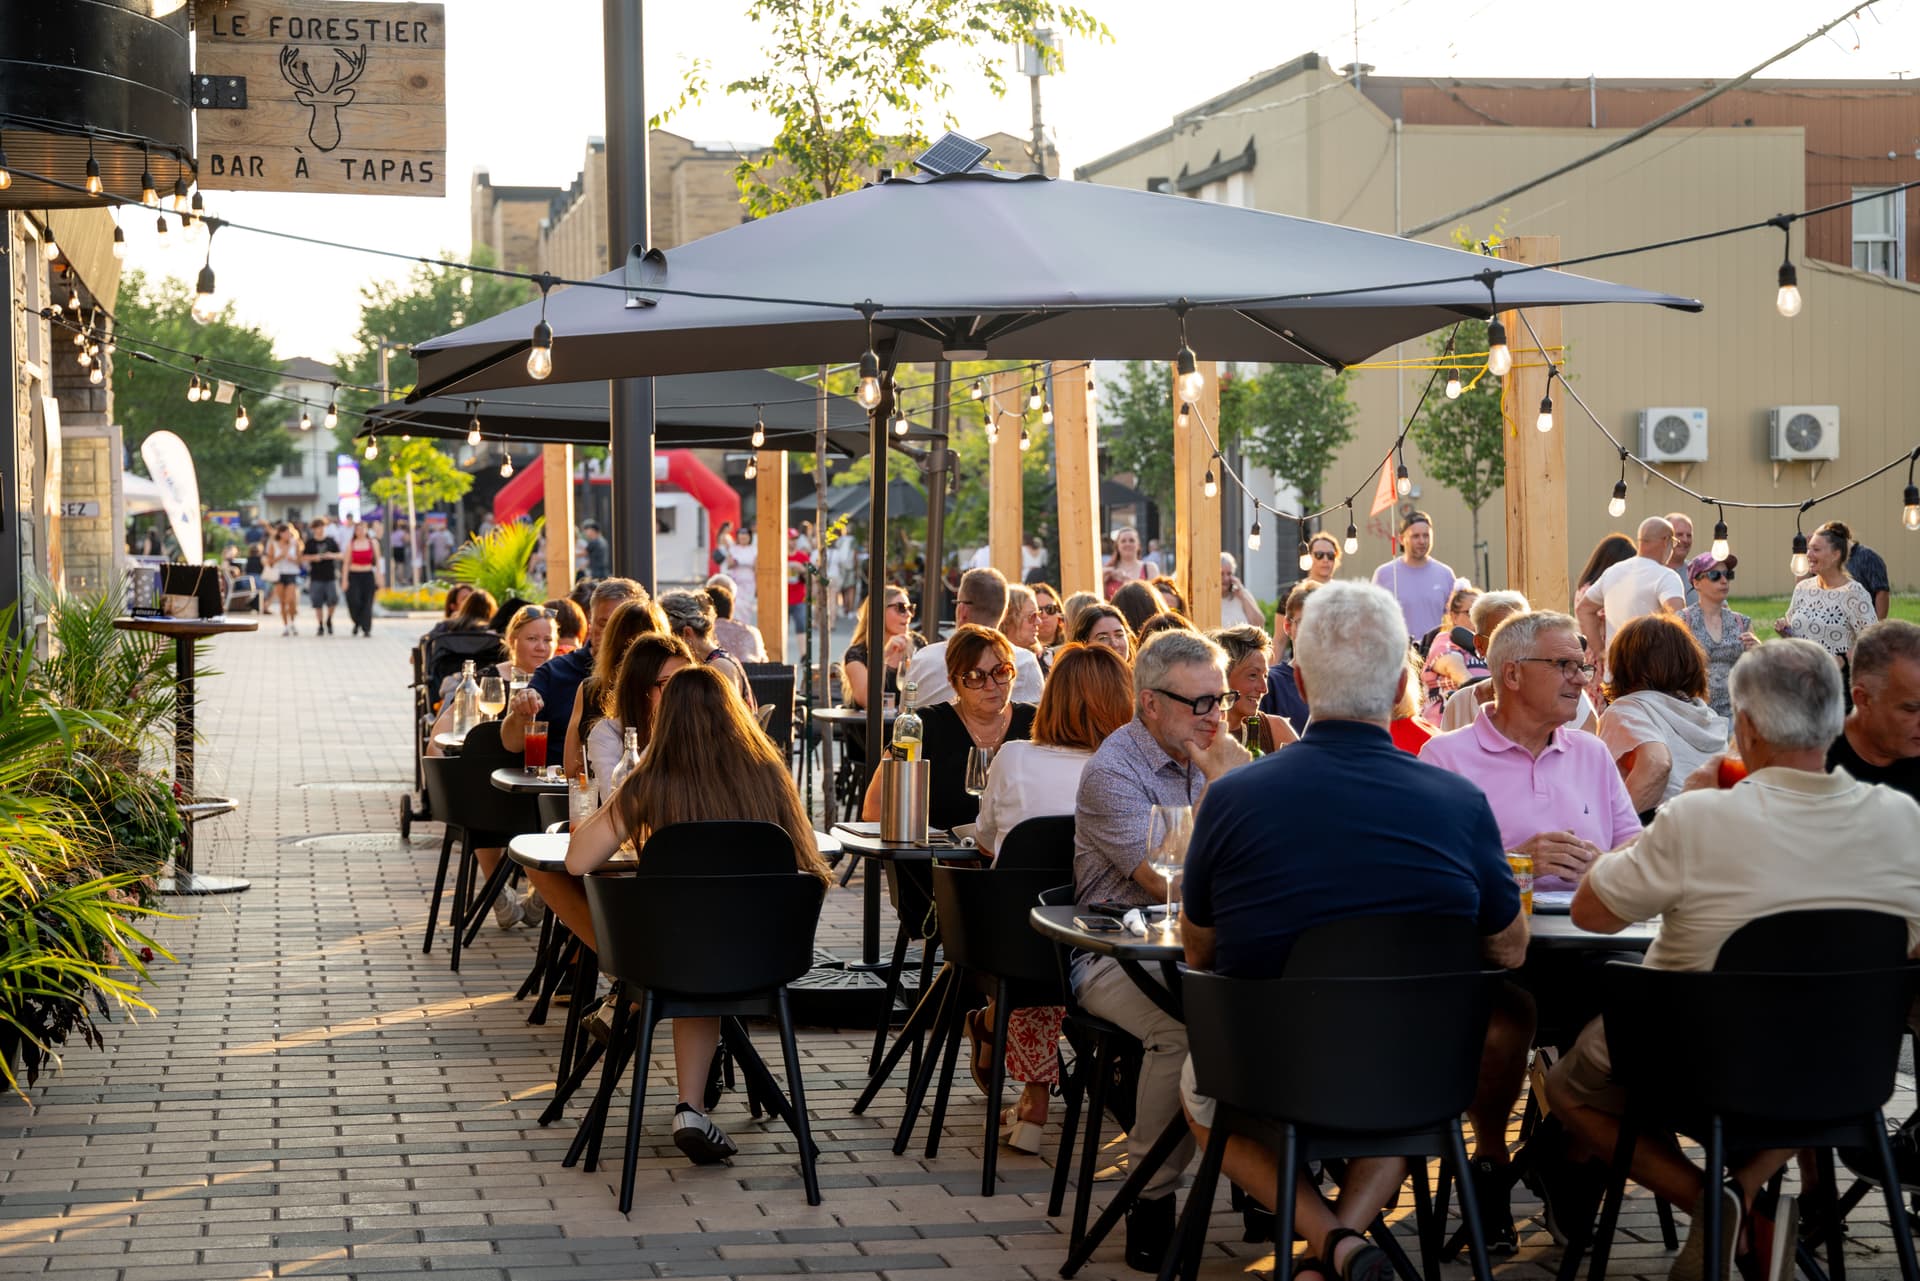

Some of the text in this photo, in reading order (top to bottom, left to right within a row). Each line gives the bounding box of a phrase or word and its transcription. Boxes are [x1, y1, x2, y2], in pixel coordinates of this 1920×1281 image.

[212, 14, 428, 43] LE FORESTIER
[210, 147, 433, 183] BAR À TAPAS
